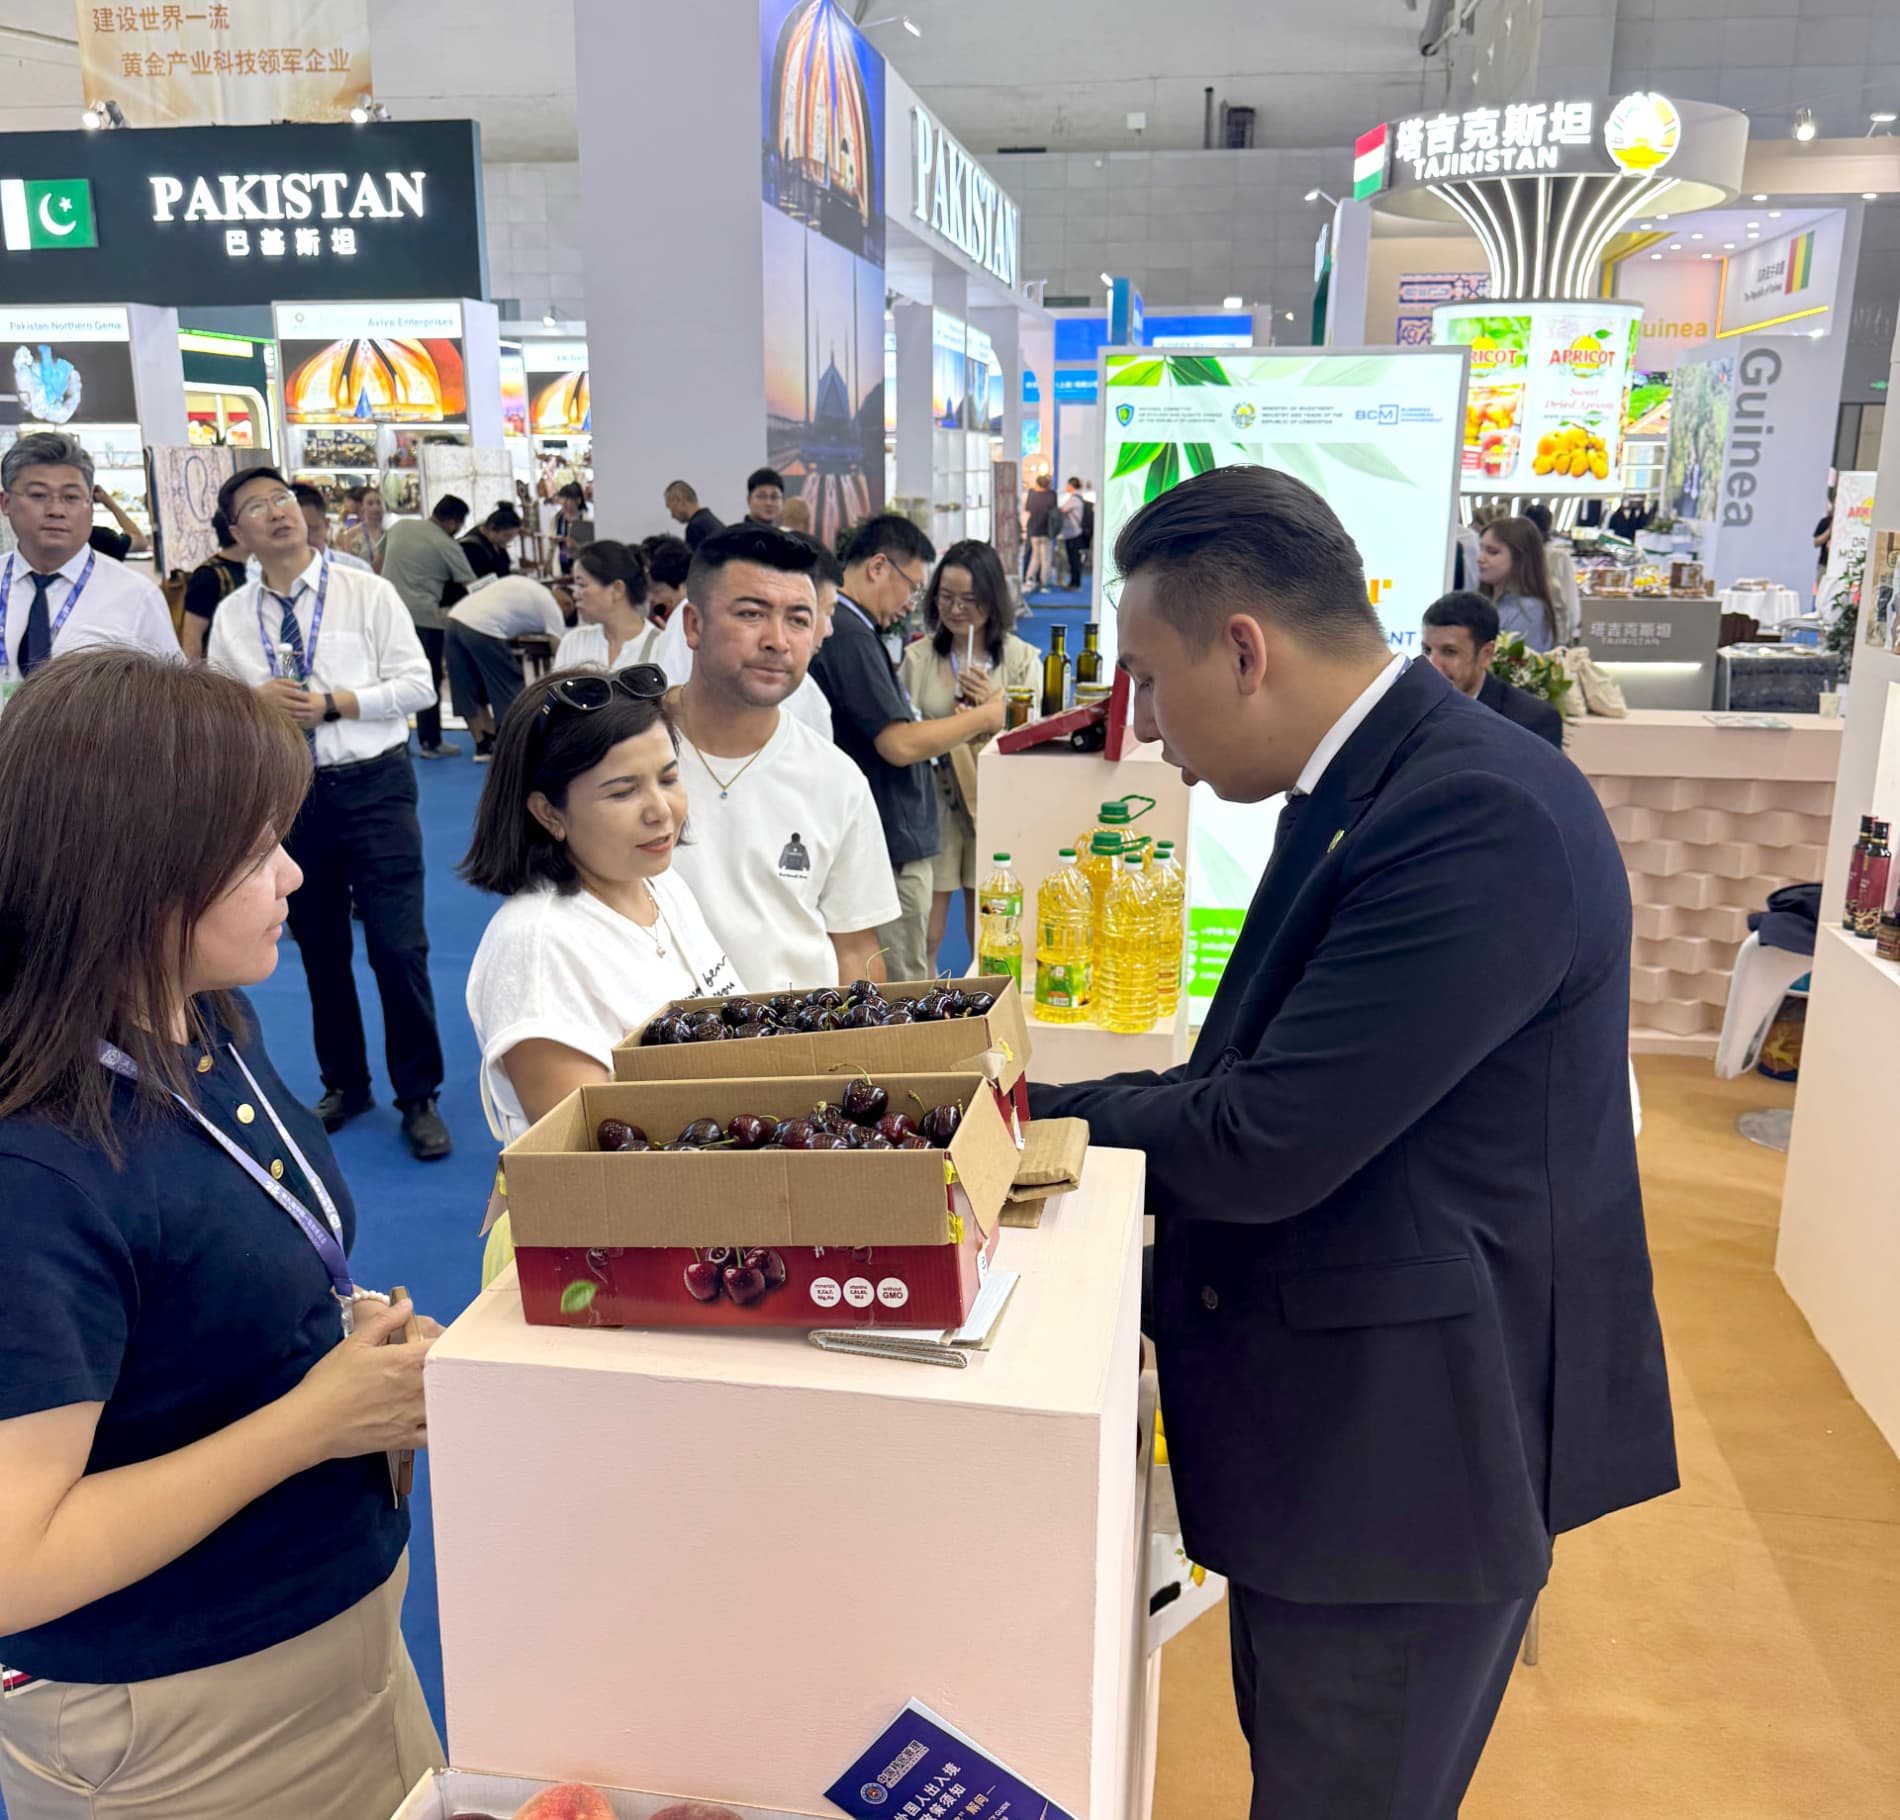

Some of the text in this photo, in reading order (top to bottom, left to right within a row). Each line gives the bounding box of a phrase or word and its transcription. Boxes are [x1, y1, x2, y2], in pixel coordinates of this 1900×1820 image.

[92, 4, 230, 33] 建设世界一流
[121, 48, 351, 78] 黄金产业科技领军企业
[1395, 101, 1593, 162] 塔吉克斯坦
[1413, 146, 1559, 181] TAJIKISTAN
[149, 171, 427, 222] PAKISTAN
[912, 104, 1018, 291] PAKISTAN
[225, 227, 357, 256] 巴基斯坦
[1643, 318, 1708, 338] uinea
[1471, 349, 1519, 365] RICOT
[1549, 349, 1615, 367] APRICOT
[1355, 408, 1394, 421] BCM
[1721, 347, 1782, 528] Guinea
[1387, 631, 1416, 646] NT
[882, 1292, 904, 1300] GMO
